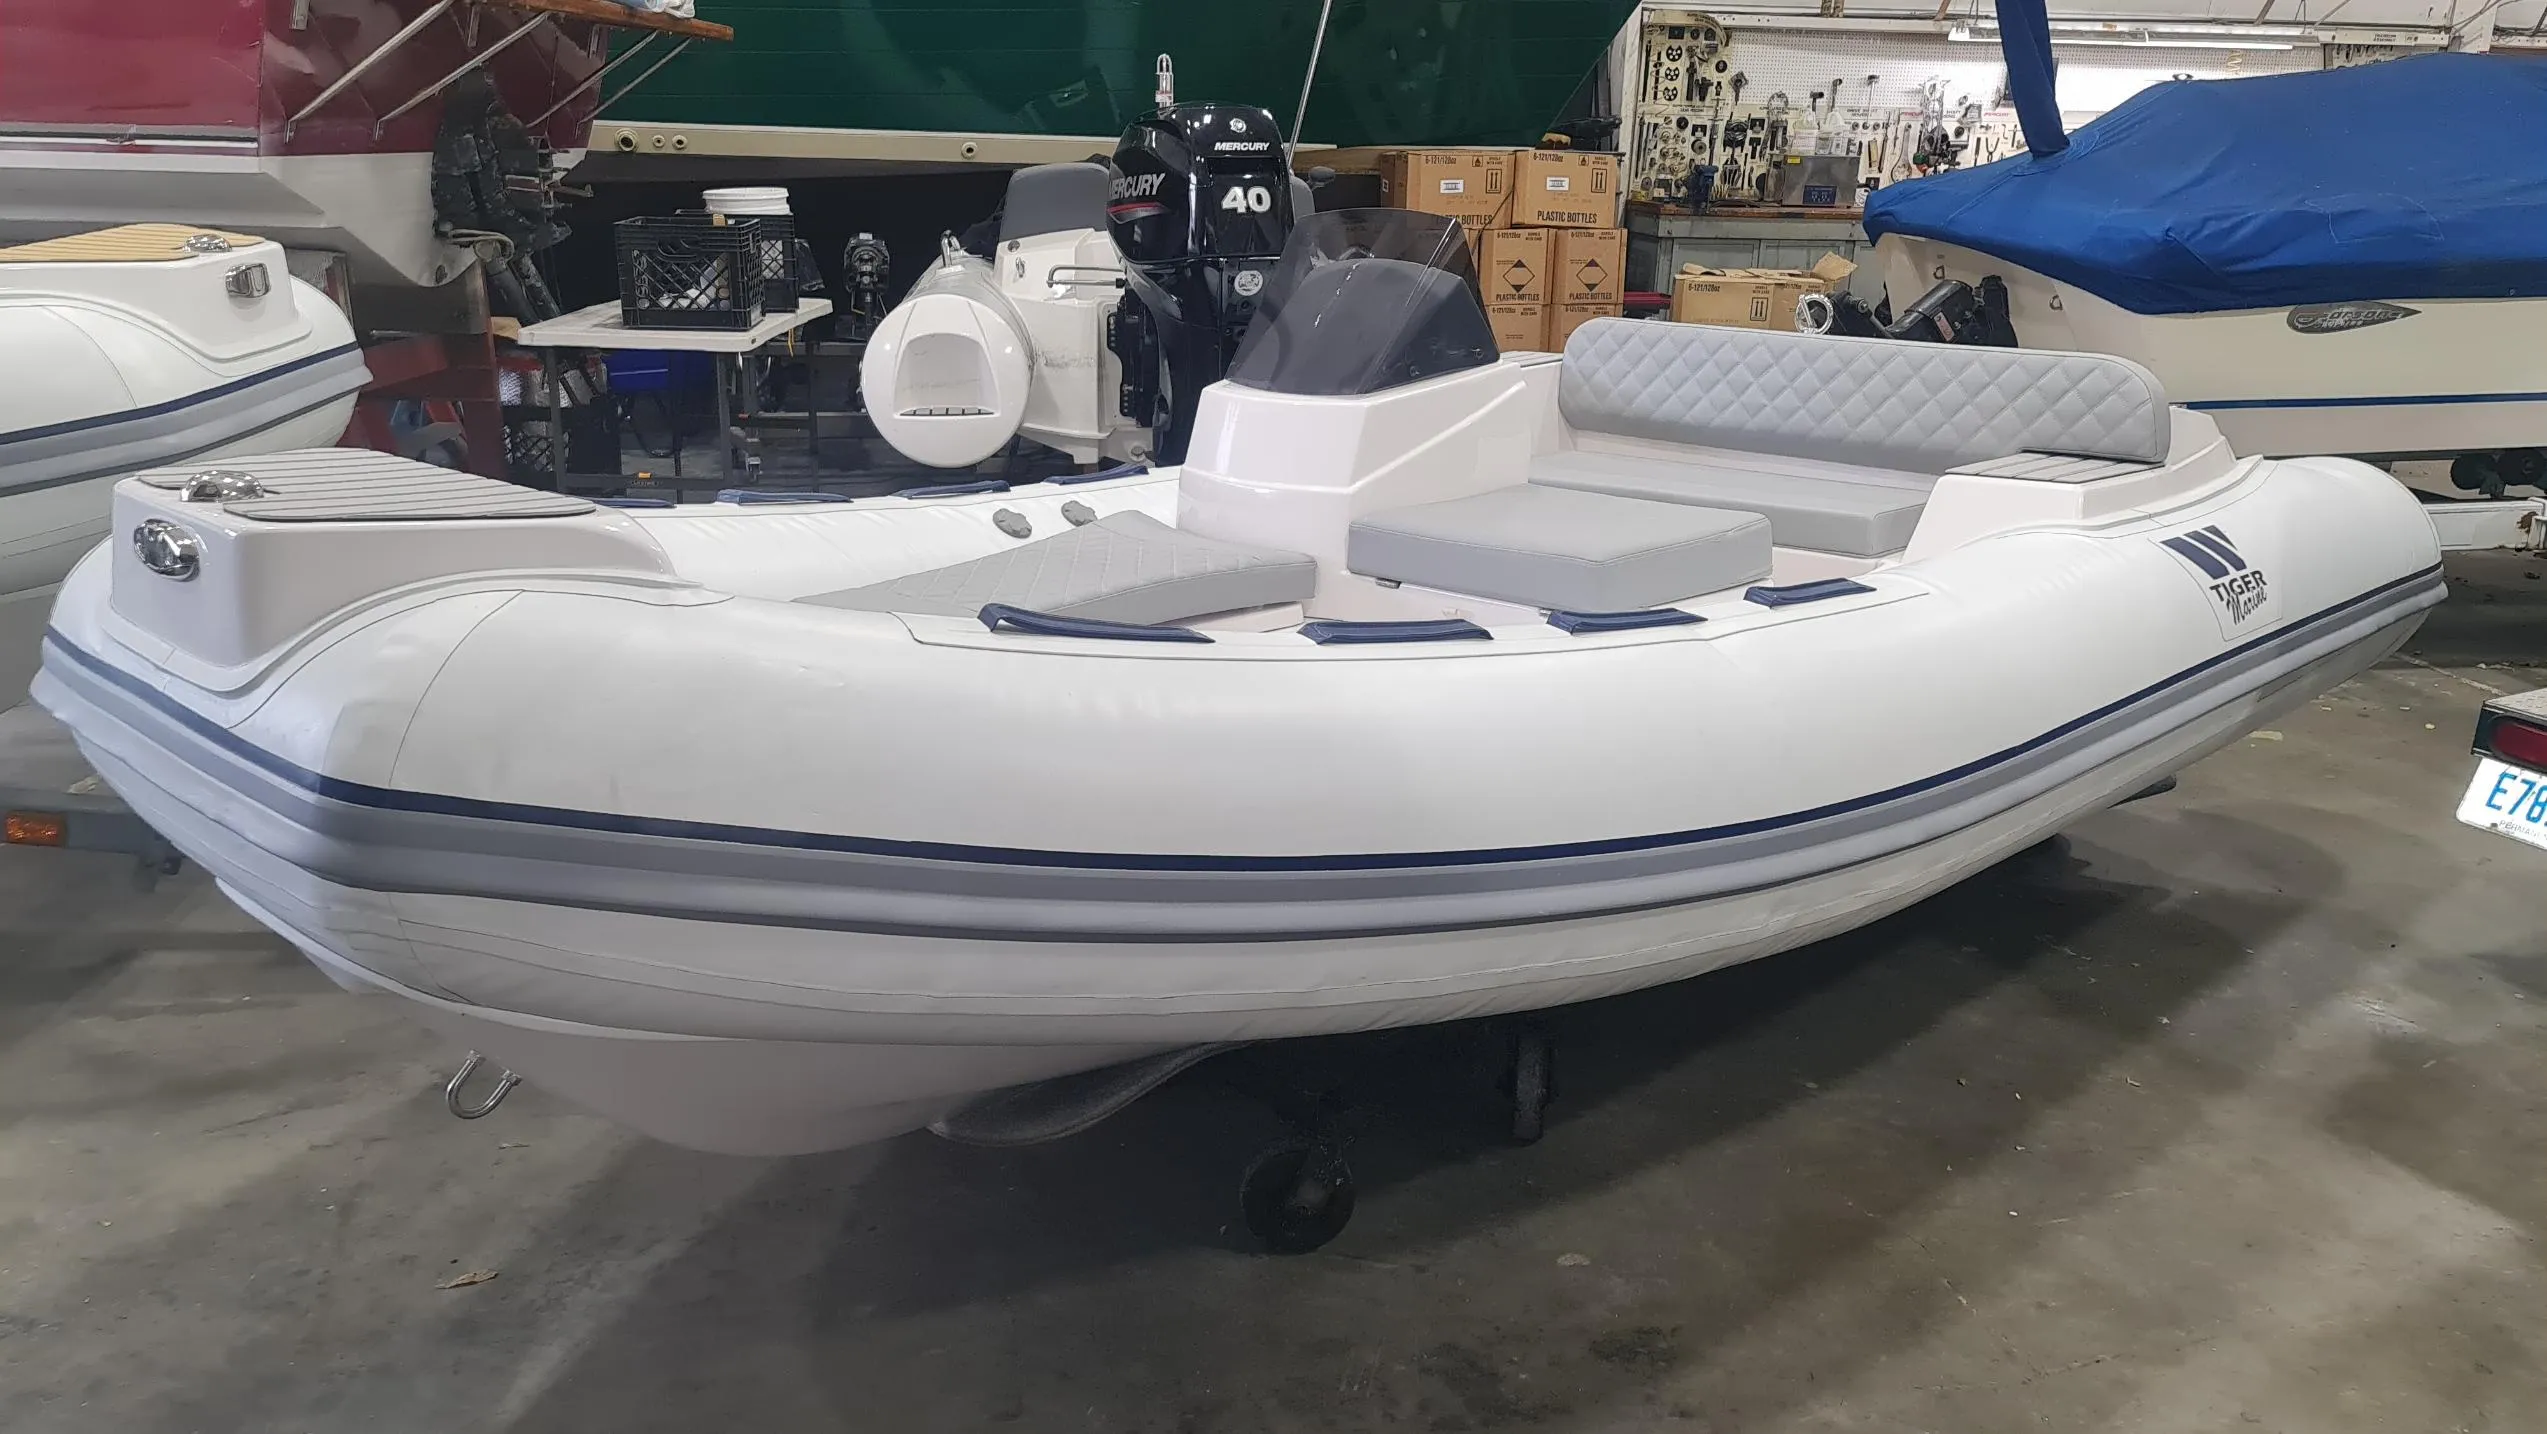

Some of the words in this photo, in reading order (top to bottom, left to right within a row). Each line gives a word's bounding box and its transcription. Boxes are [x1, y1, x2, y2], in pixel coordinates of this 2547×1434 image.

[1214, 141, 1270, 151] MERCURY
[1533, 152, 1564, 163] 6-121/128oz
[1221, 186, 1272, 213] 40
[1461, 214, 1493, 225] BOTTLES
[1537, 210, 1566, 222] PLASTIC
[1566, 211, 1598, 224] BOTTLES
[1688, 283, 1721, 293] 6-121/128oz
[1495, 293, 1517, 302] PLASTIC
[1517, 293, 1540, 301] BOTTLES
[1569, 292, 1591, 300] PLASTIC
[1590, 292, 1613, 300] BOTTLES
[2209, 570, 2268, 602] TIGER
[2226, 587, 2268, 626] Marine
[2485, 772, 2547, 826] E78
